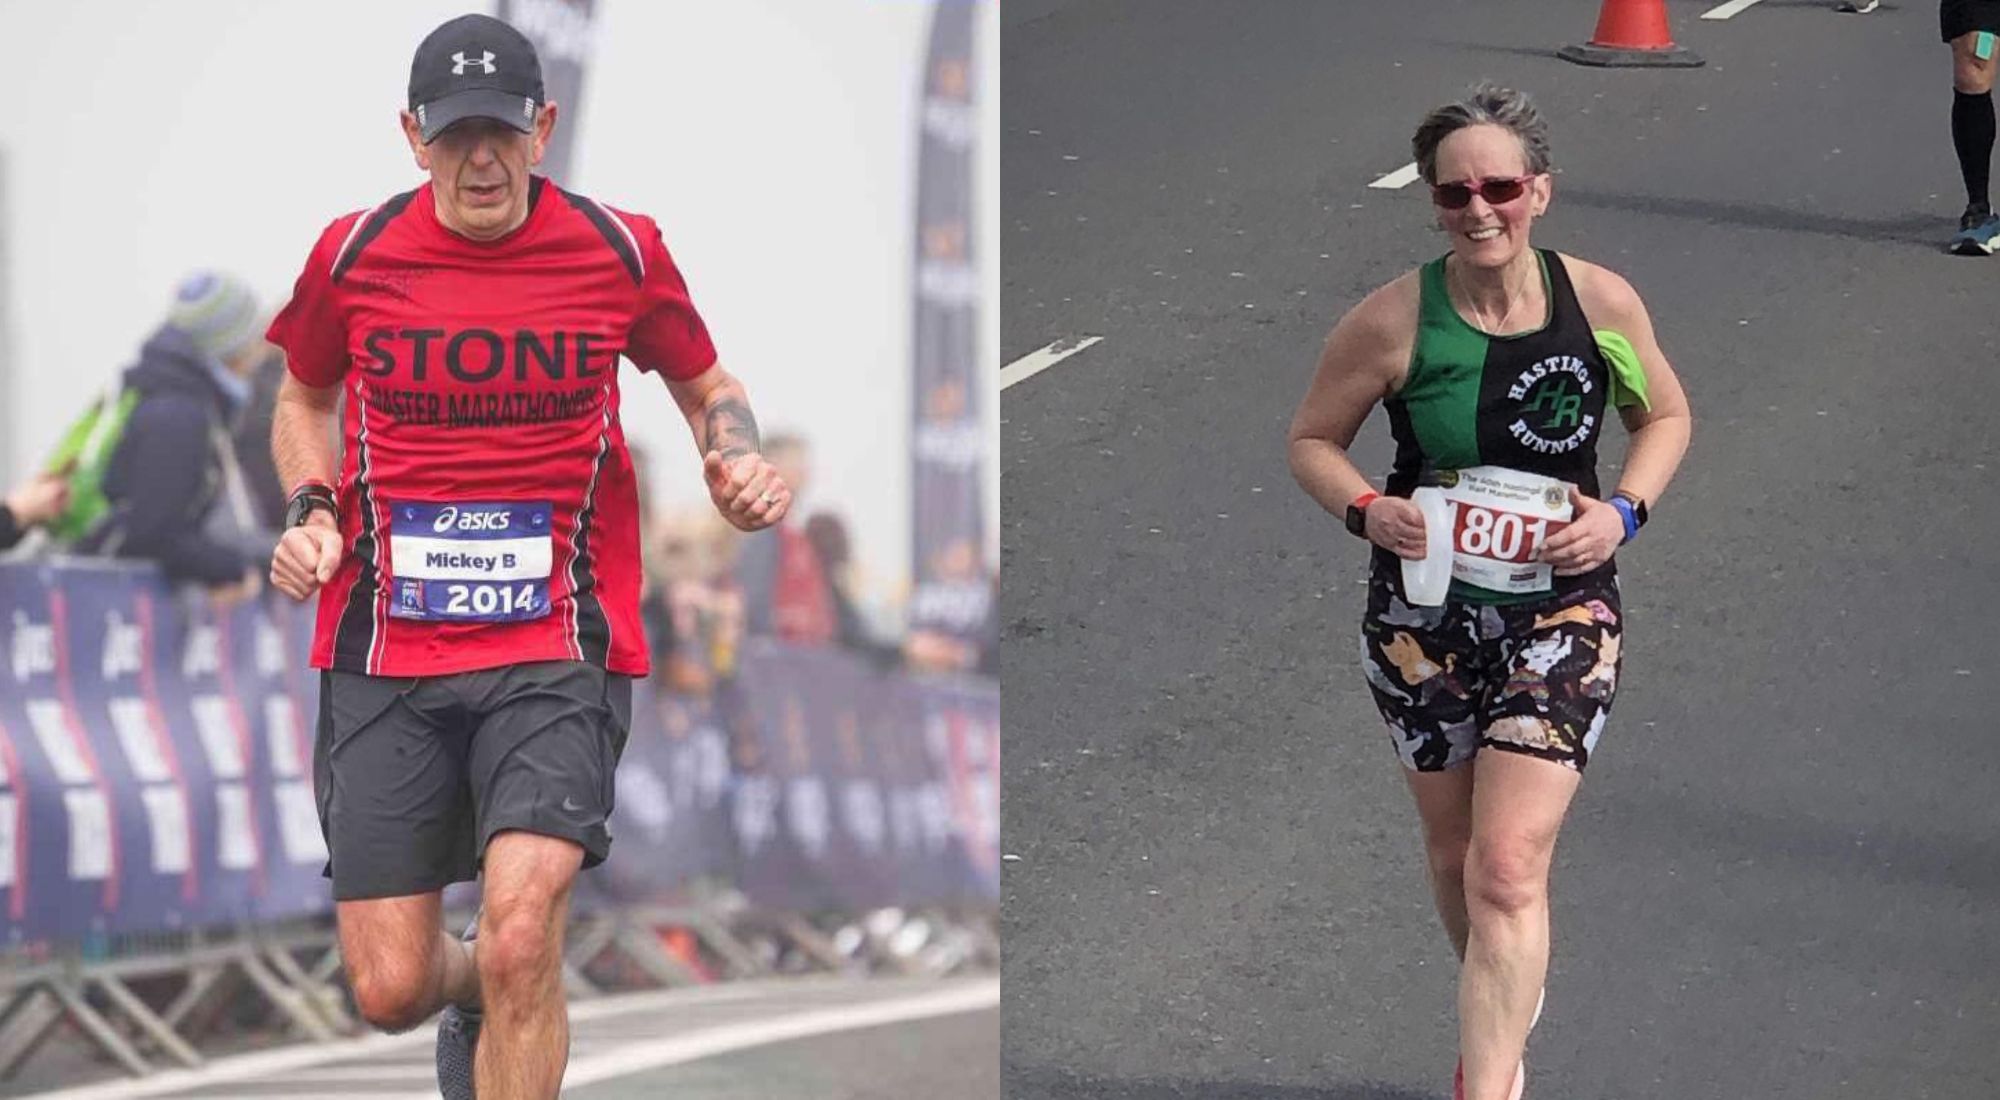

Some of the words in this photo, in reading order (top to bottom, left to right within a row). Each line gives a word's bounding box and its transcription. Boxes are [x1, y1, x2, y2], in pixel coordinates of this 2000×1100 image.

[364, 328, 606, 382] STONE
[1507, 355, 1593, 401] HASTINGS
[448, 388, 598, 430] MARATHON
[1508, 418, 1595, 455] RUNNERS
[458, 511, 511, 530] asics
[426, 551, 497, 572] Mickey
[502, 553, 516, 569] B
[446, 583, 535, 614] 2014
